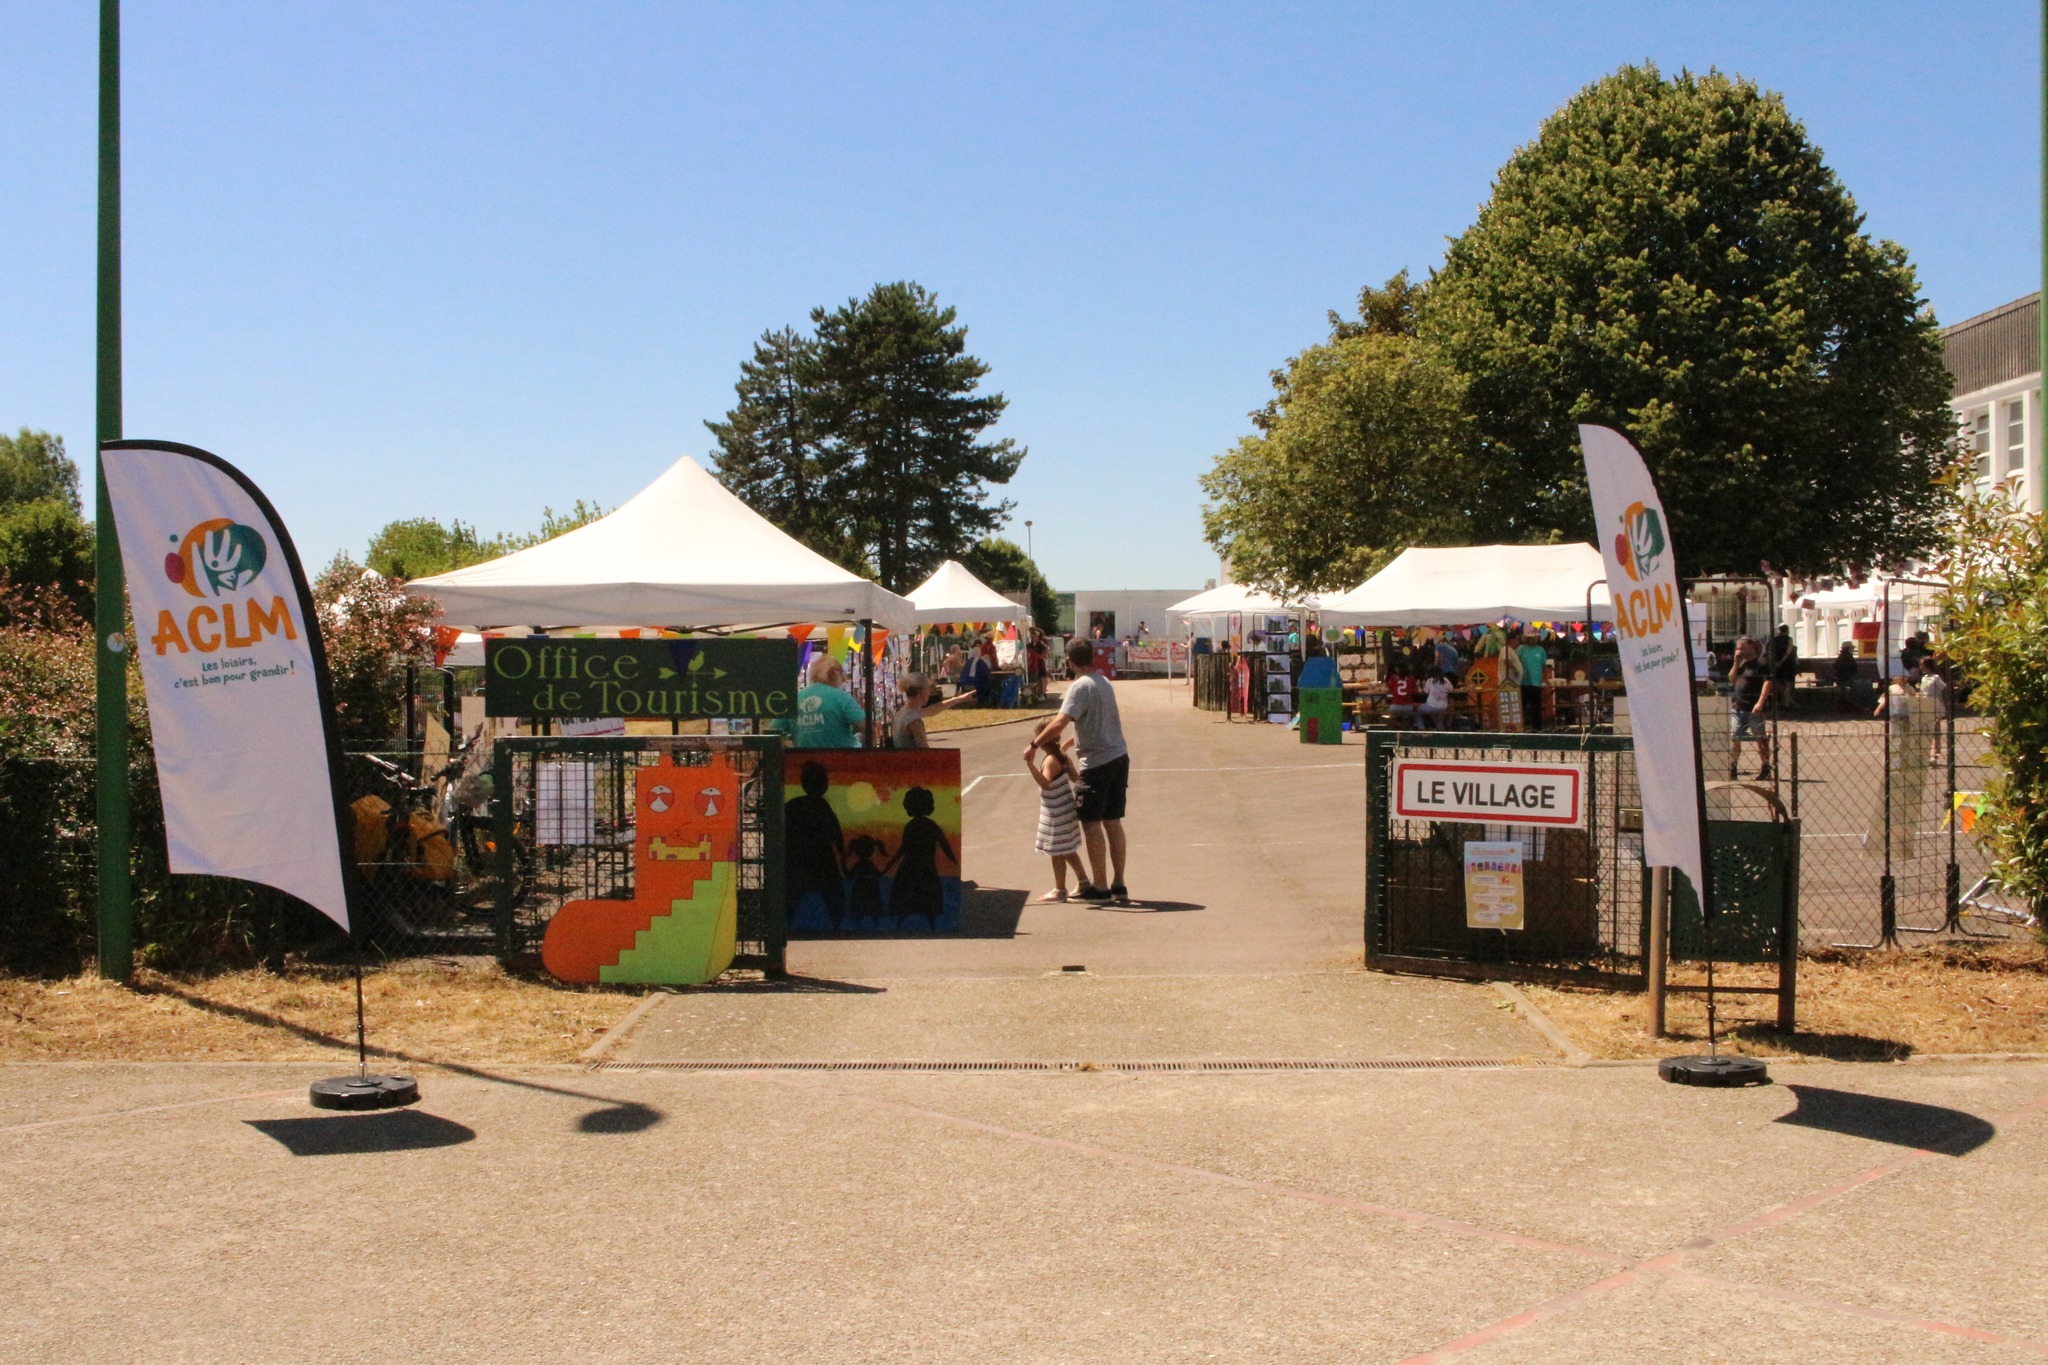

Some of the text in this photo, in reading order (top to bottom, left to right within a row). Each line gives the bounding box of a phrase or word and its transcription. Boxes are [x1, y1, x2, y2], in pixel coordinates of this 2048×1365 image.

[151, 596, 298, 656] ACLM
[202, 657, 257, 672] Les loisirs,
[493, 645, 639, 679] Office
[174, 677, 200, 688] c'est
[201, 674, 221, 685] bon
[223, 673, 247, 685] pour
[1397, 680, 1408, 696] 2
[532, 680, 789, 715] de Tourisme
[797, 712, 825, 727] ACLM
[1417, 780, 1555, 809] LE VILLAGE
